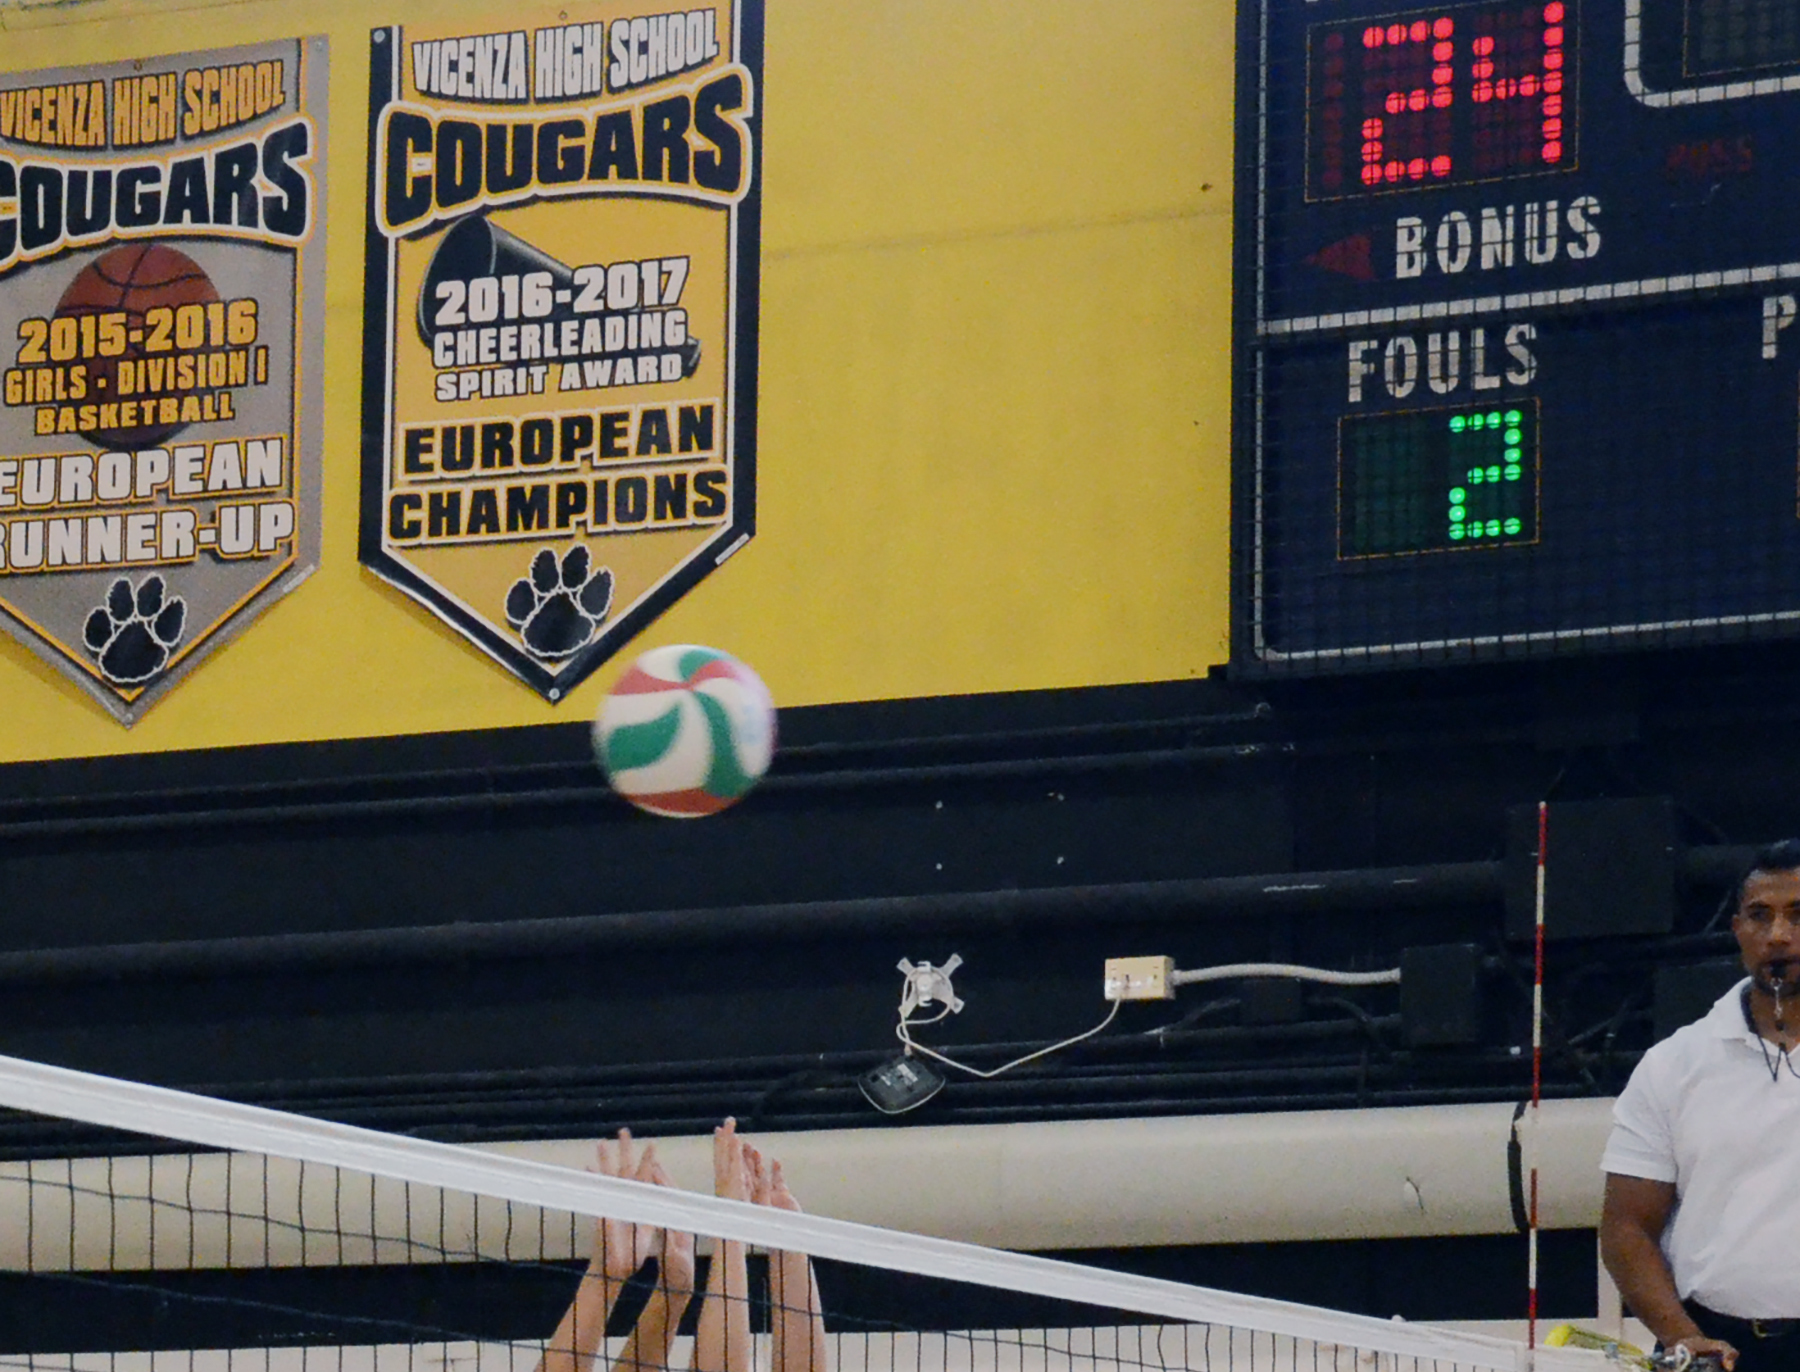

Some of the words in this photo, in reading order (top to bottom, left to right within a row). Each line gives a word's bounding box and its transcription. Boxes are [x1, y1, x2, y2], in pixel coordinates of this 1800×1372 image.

[412, 31, 528, 99] VICENZA
[535, 22, 604, 98] HIGH
[609, 9, 719, 89] SCHOOL
[0, 80, 106, 147] VICENZA
[112, 72, 177, 146] HIGH
[182, 60, 285, 137] SCHOOL
[1363, 2, 1564, 184] 24
[386, 74, 743, 227] COUGARS
[1395, 196, 1602, 280] BONUS
[435, 256, 690, 326] 2016-2017
[18, 300, 258, 364] 2015-2016
[433, 310, 687, 368] CHEERLEADING
[1348, 323, 1538, 402] FOULS
[5, 366, 88, 404] GIRLS
[117, 351, 247, 395] DIVISION
[436, 366, 549, 401] SPIRIT
[559, 354, 683, 392] AWARD
[35, 393, 235, 435] BASKETBALL
[405, 404, 715, 475] EUROPEAN
[389, 470, 728, 539] CHAMPIONS
[1448, 409, 1523, 541] 2
[0, 502, 294, 570] UNNER-UP
